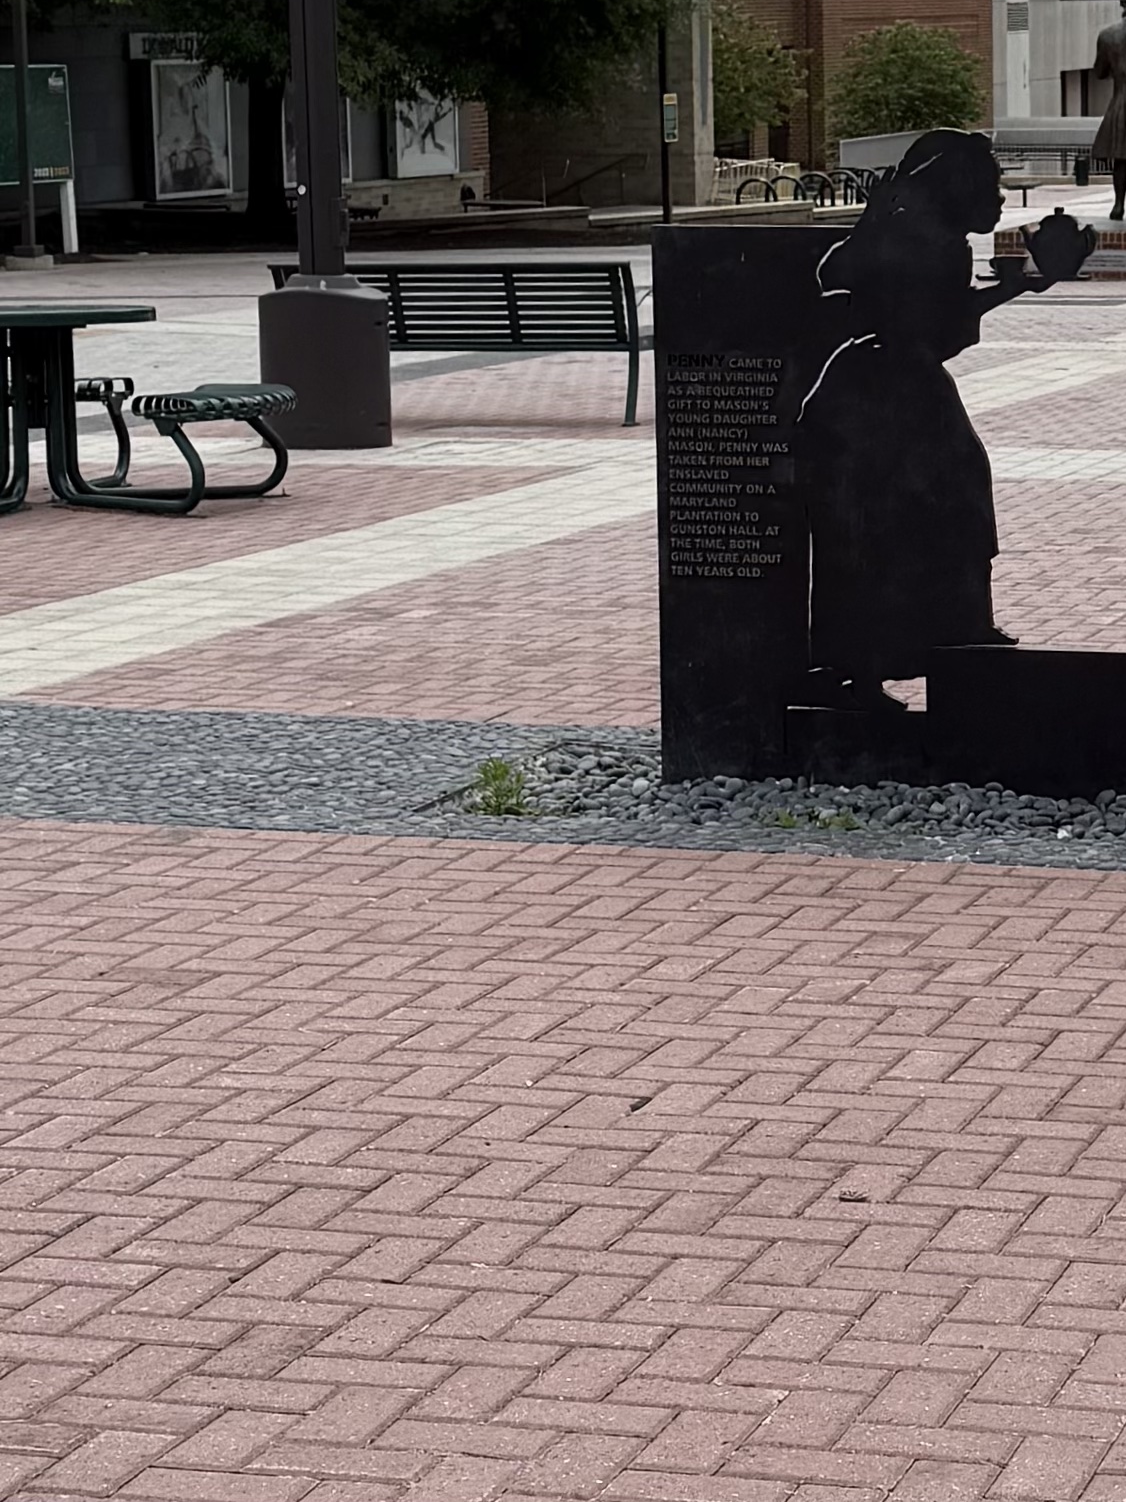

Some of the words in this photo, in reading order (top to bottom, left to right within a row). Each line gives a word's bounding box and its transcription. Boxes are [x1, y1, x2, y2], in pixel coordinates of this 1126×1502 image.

[667, 354, 725, 368] PENNY
[729, 358, 763, 369] CAME
[767, 359, 782, 369] TO
[667, 372, 706, 382] LABOR
[709, 373, 721, 382] IN
[725, 373, 778, 383] VIRGINIA
[667, 386, 683, 396] AS
[686, 386, 696, 396] A
[699, 386, 774, 397] BEQUEATHED
[668, 400, 692, 410] GIFT
[696, 400, 711, 410] TO
[714, 401, 769, 411] MASON'S
[668, 414, 710, 424] YOUNG
[714, 414, 777, 425] DAUGHTER
[668, 428, 695, 437] ANN
[698, 428, 748, 440] (NANCY)
[719, 442, 758, 453] PENNY
[762, 443, 789, 453] WAS
[669, 455, 707, 466] TAKEN
[710, 456, 744, 466] FROM
[747, 457, 770, 466] HER
[669, 470, 729, 480] ENSLAVED
[670, 483, 743, 494] COMMUNITY
[747, 484, 763, 494] ON
[767, 485, 776, 494] A
[670, 497, 737, 508] MARYLAND
[670, 510, 741, 521] PLANTATION
[744, 512, 759, 522] TO
[670, 524, 726, 535] GUNSTON
[765, 526, 780, 536] AT
[671, 538, 692, 548] THE
[730, 539, 760, 549] BOTH
[671, 552, 703, 562] GIRLS
[707, 552, 739, 563] WERE
[743, 553, 782, 563] ABOUT
[671, 566, 693, 576] TEN
[696, 566, 734, 577] YEARS
[737, 567, 764, 577] OLD.
